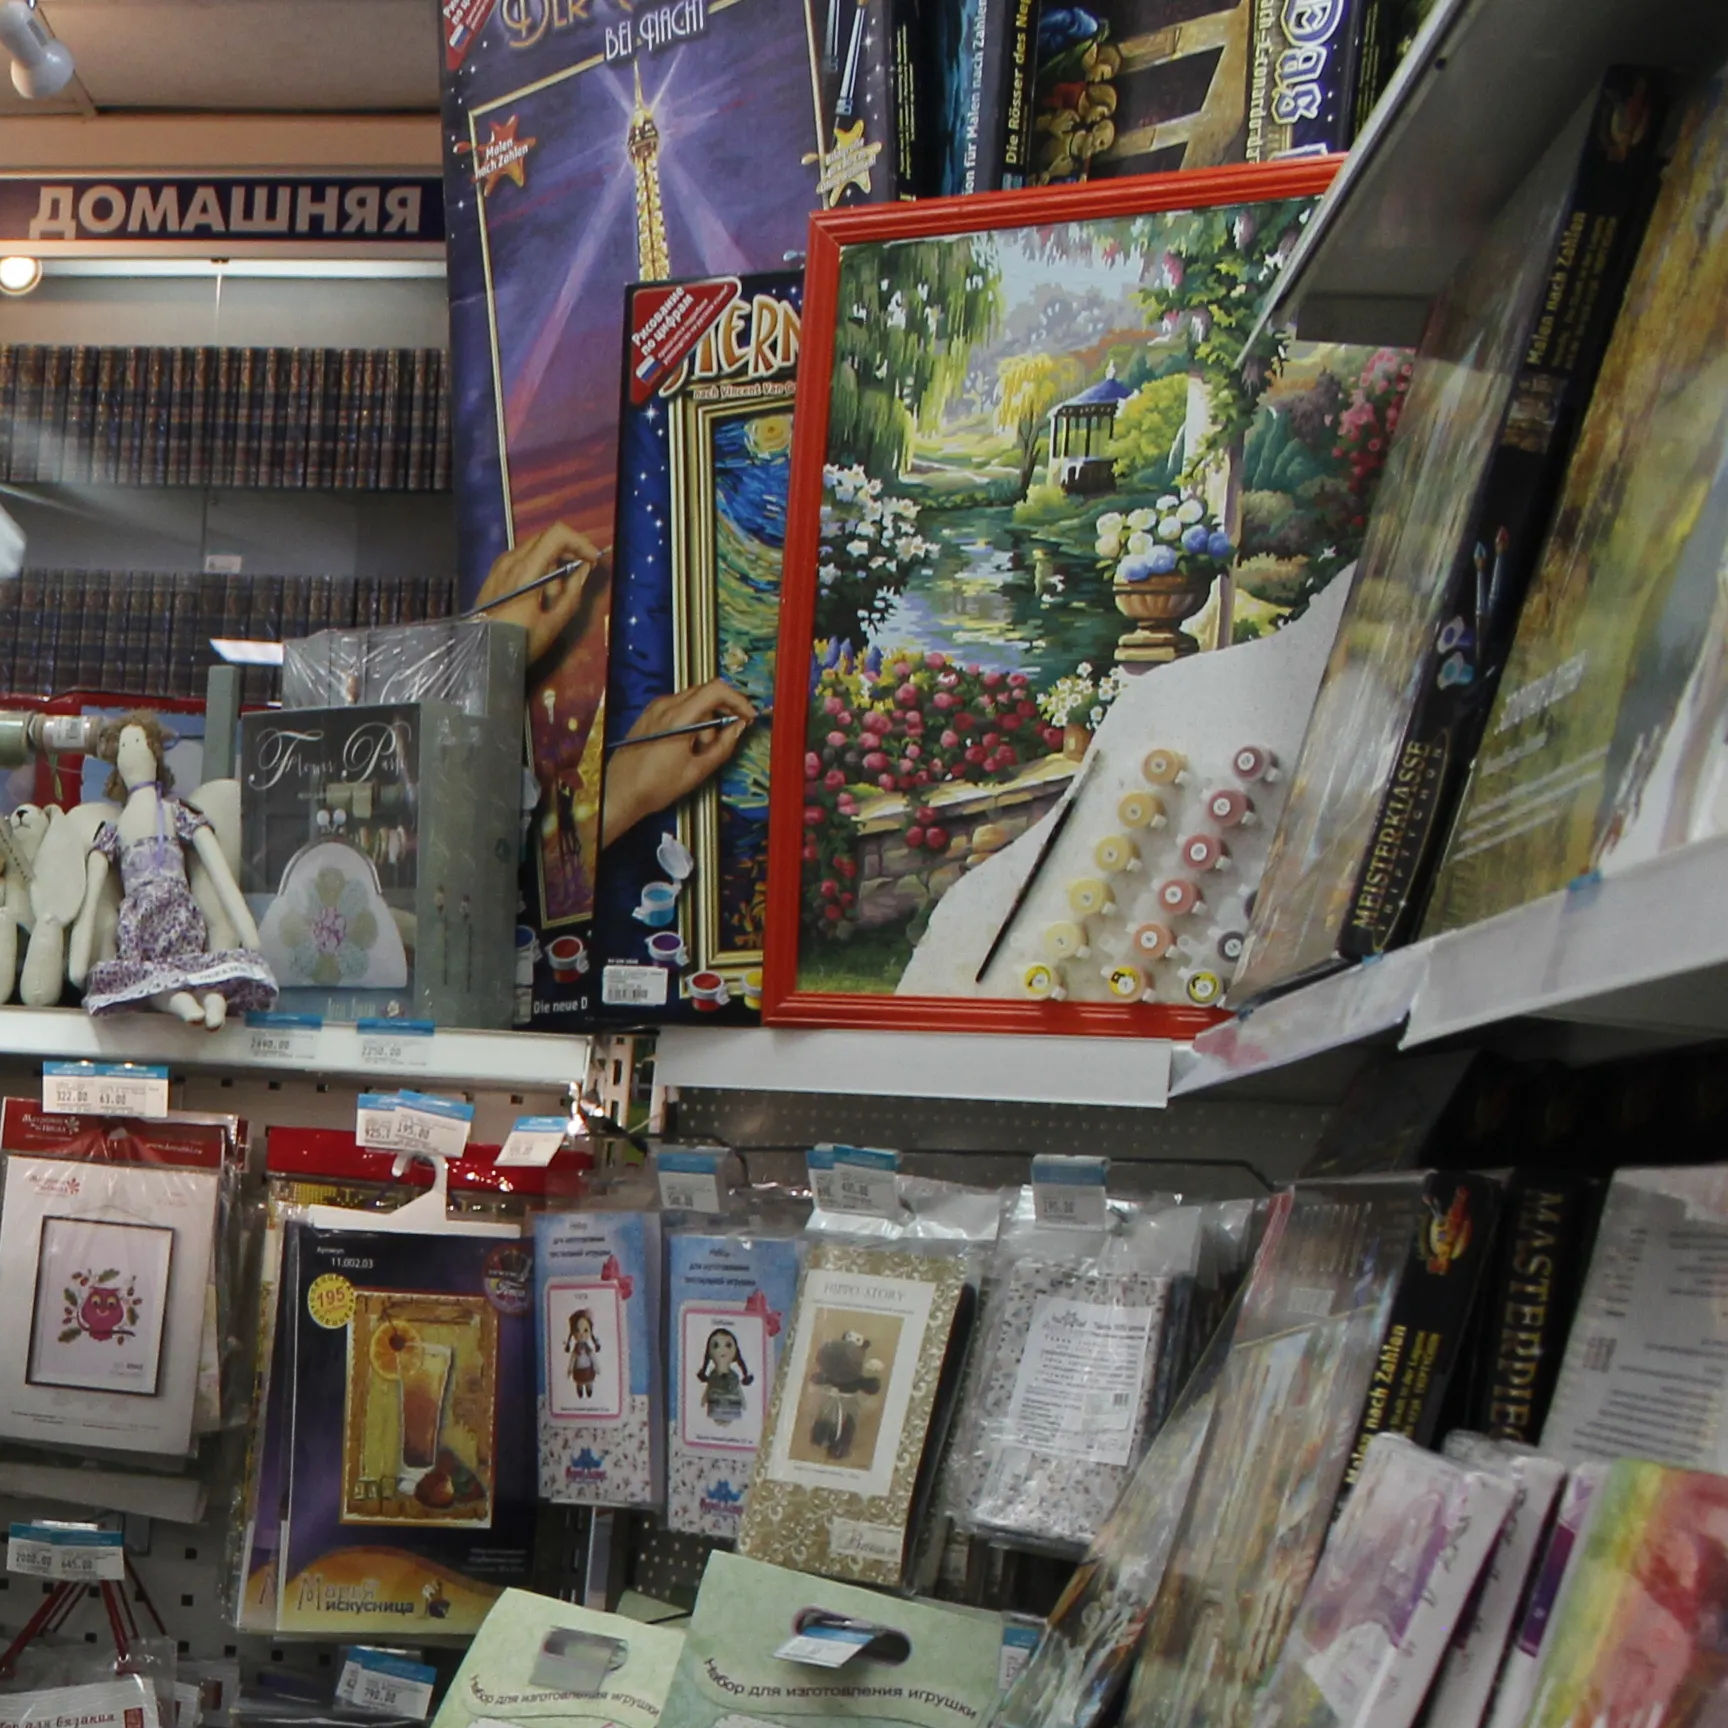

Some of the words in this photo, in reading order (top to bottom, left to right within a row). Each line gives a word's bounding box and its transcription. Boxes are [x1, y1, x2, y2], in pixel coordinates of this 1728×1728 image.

[30, 184, 423, 240] ДОМАШНЯЯ
[630, 286, 685, 347] Рисование
[640, 334, 656, 358] по
[652, 294, 695, 339] цифрам
[315, 1287, 346, 1309] 195
[1364, 1382, 1389, 1430] nach
[324, 1599, 415, 1615] искусница
[701, 1656, 747, 1698] Набор
[748, 1684, 783, 1699] для
[785, 1683, 904, 1701] изготовления
[907, 1684, 979, 1720] игрушки
